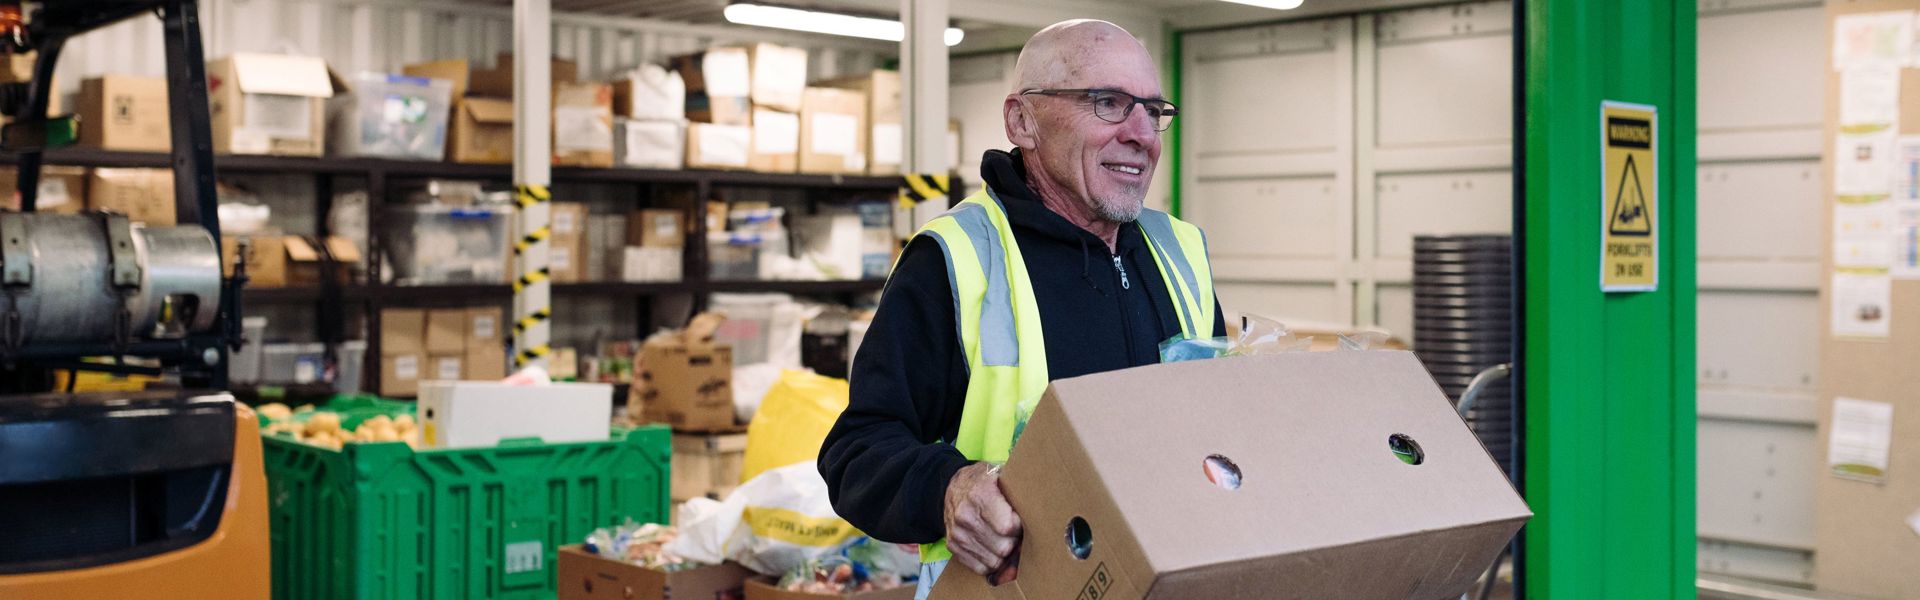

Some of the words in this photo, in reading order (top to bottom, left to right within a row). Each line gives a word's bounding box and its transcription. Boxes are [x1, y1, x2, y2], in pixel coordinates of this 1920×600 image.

[1610, 124, 1649, 142] WARNING
[1608, 243, 1651, 257] FORKLIFTS
[1615, 263, 1626, 277] IN
[1629, 262, 1643, 277] USE
